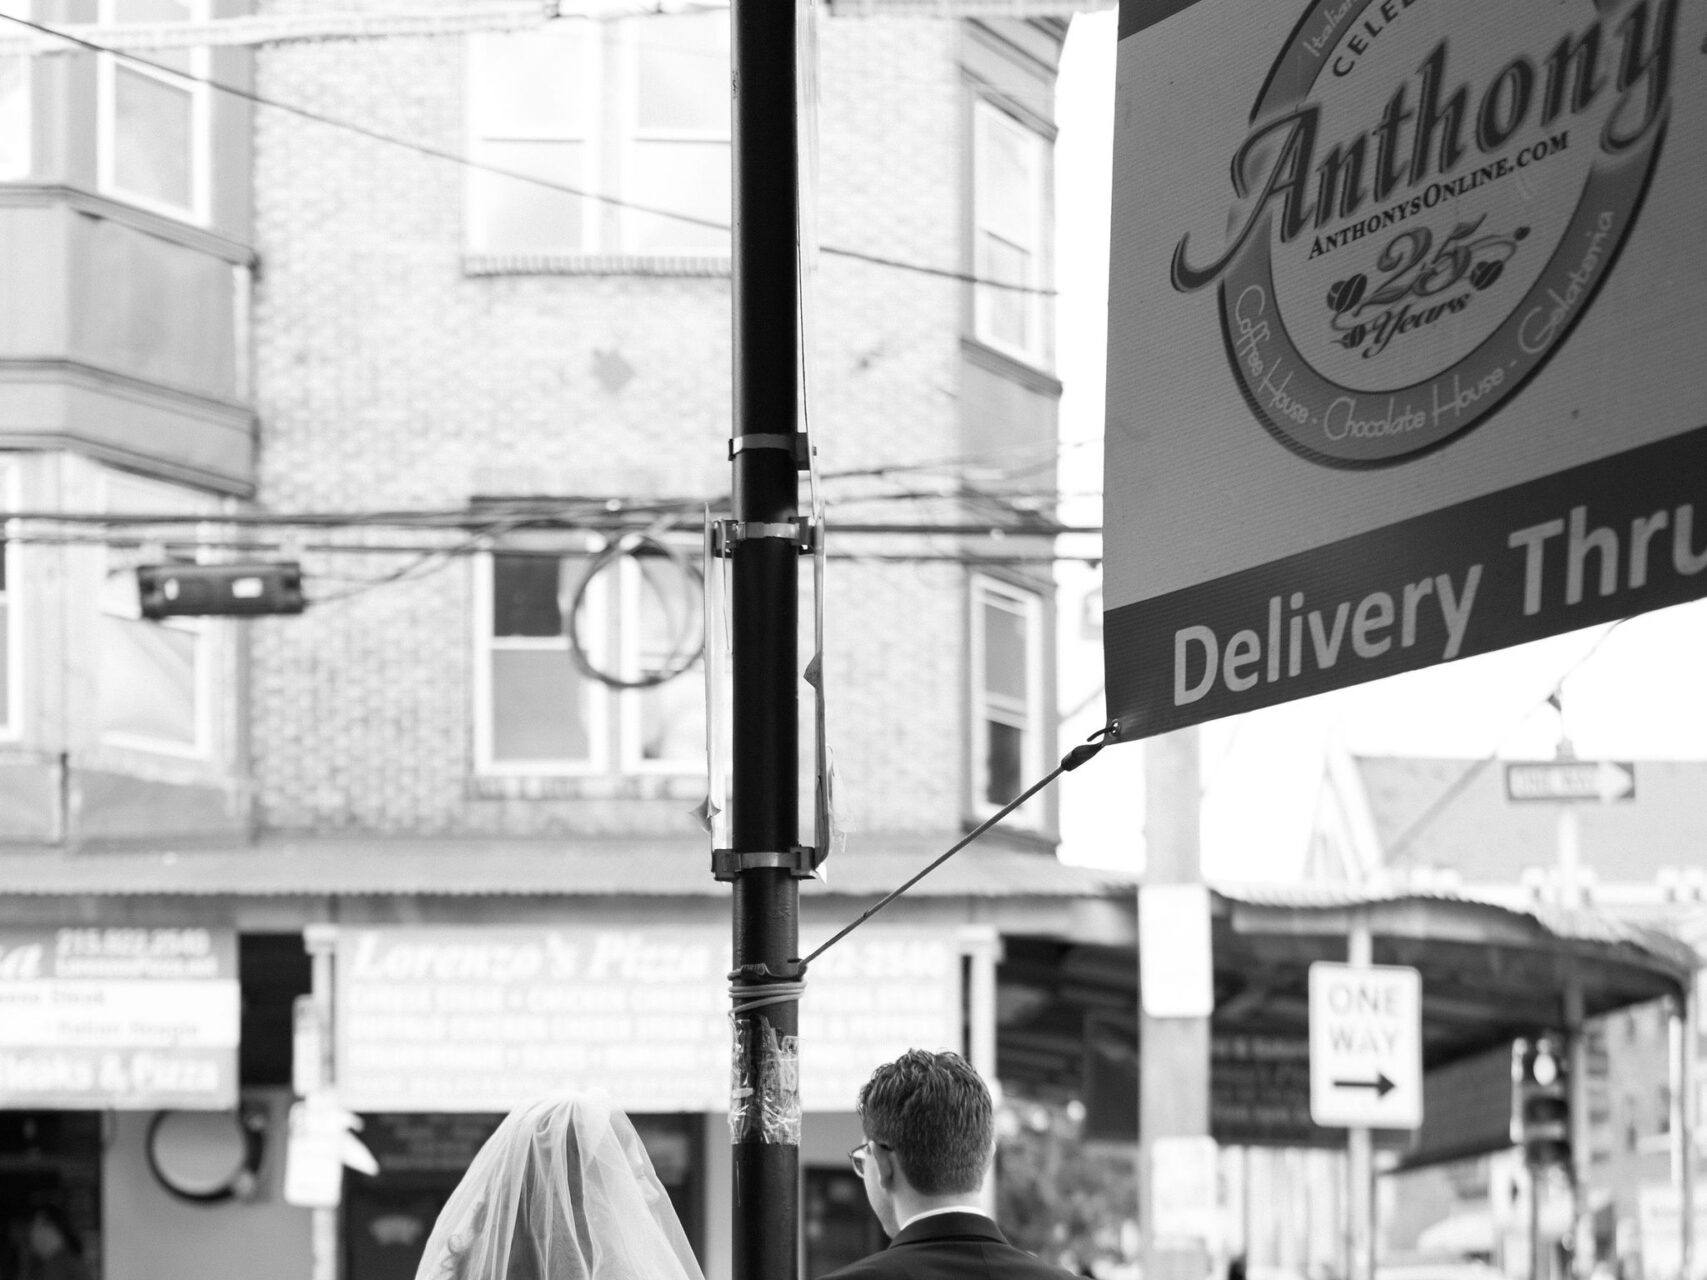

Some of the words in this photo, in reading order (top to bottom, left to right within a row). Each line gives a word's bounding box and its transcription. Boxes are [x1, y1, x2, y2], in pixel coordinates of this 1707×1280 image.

[1332, 0, 1417, 77] CELE
[1354, 213, 1487, 317] 25
[1235, 284, 1270, 377] Coffee
[1258, 356, 1309, 424] House
[1324, 396, 1426, 441] Chocolate
[1432, 367, 1505, 428] House
[1518, 210, 1616, 354] Gelateria
[1362, 293, 1470, 359] Years
[1174, 564, 1484, 706] Delivery
[1508, 504, 1707, 616] Thru
[352, 931, 578, 979] Lorenzo's
[589, 930, 712, 981] Pizza
[1328, 982, 1399, 1019] ONE
[1329, 1024, 1400, 1055] WAY
